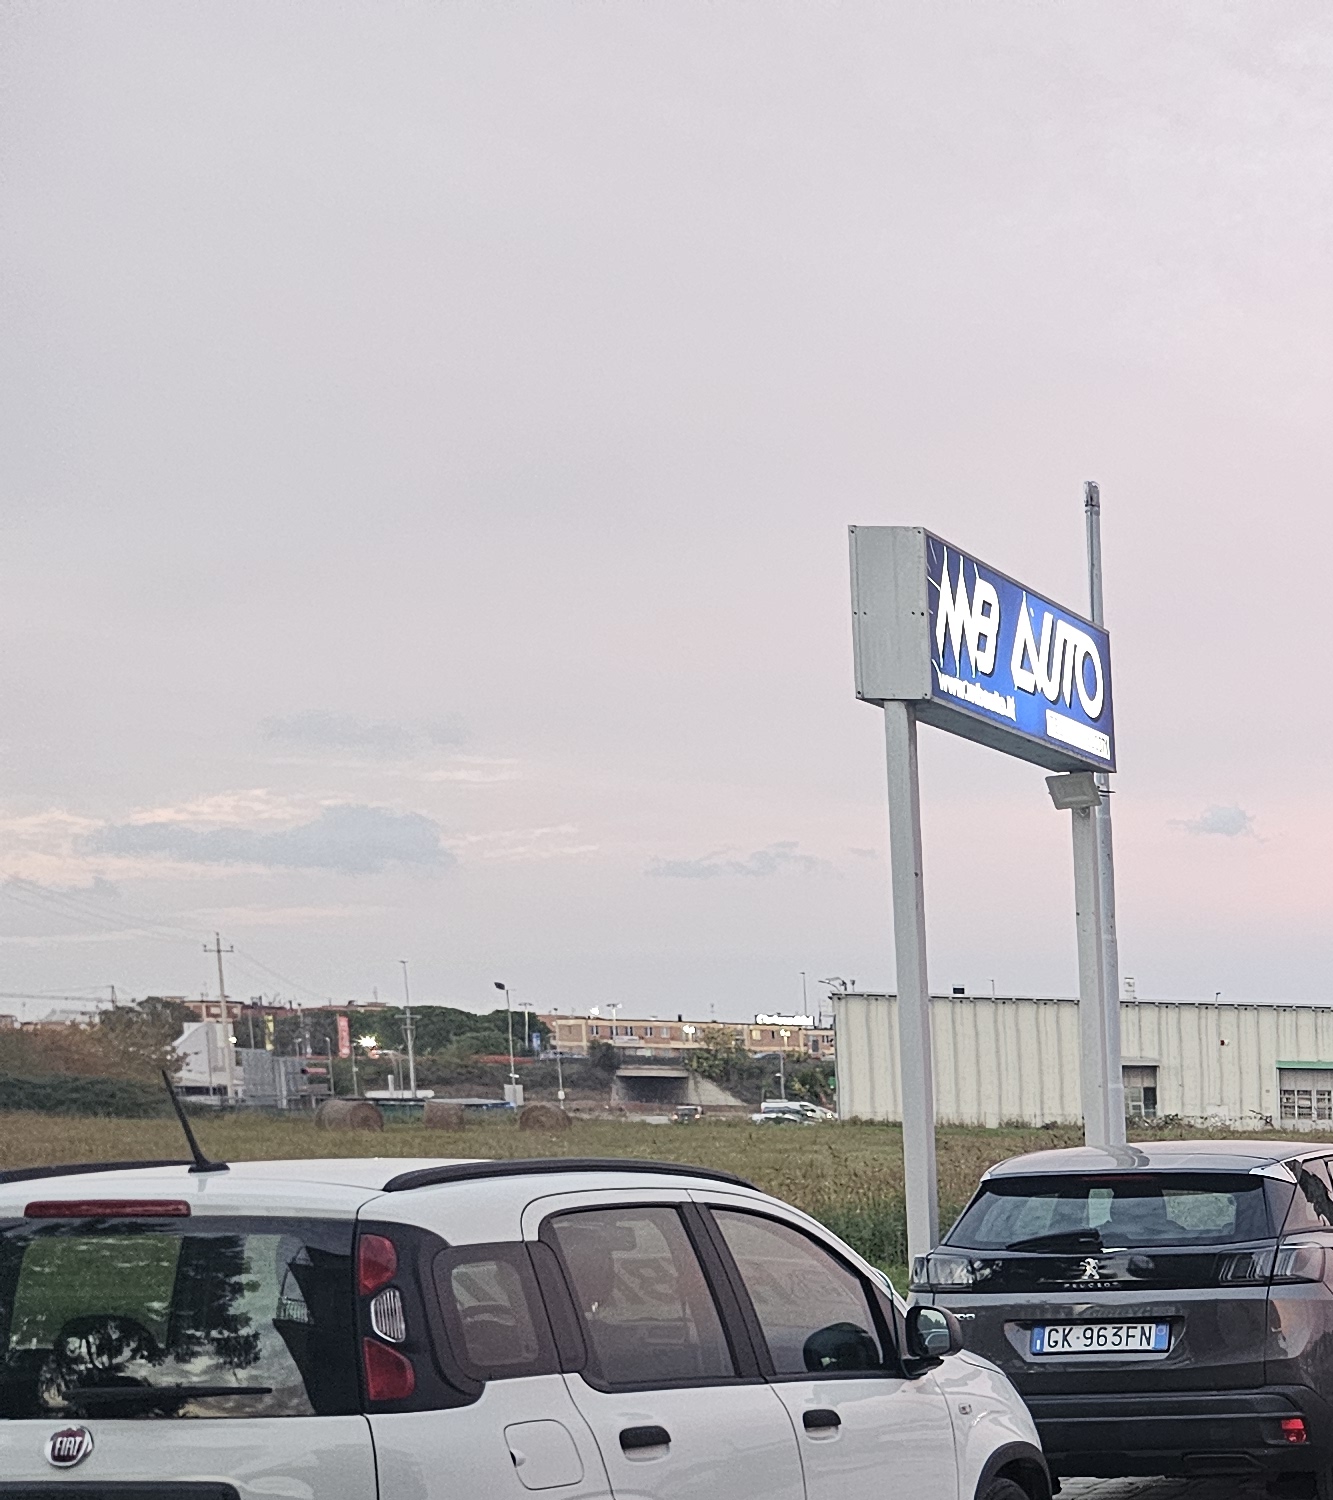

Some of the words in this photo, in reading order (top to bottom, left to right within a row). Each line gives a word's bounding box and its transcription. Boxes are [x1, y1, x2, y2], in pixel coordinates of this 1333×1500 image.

[1010, 590, 1105, 722] AUTO
[1047, 1326, 1074, 1349] GK
[1082, 1325, 1153, 1348] 963FN
[54, 1436, 84, 1457] FIAT
